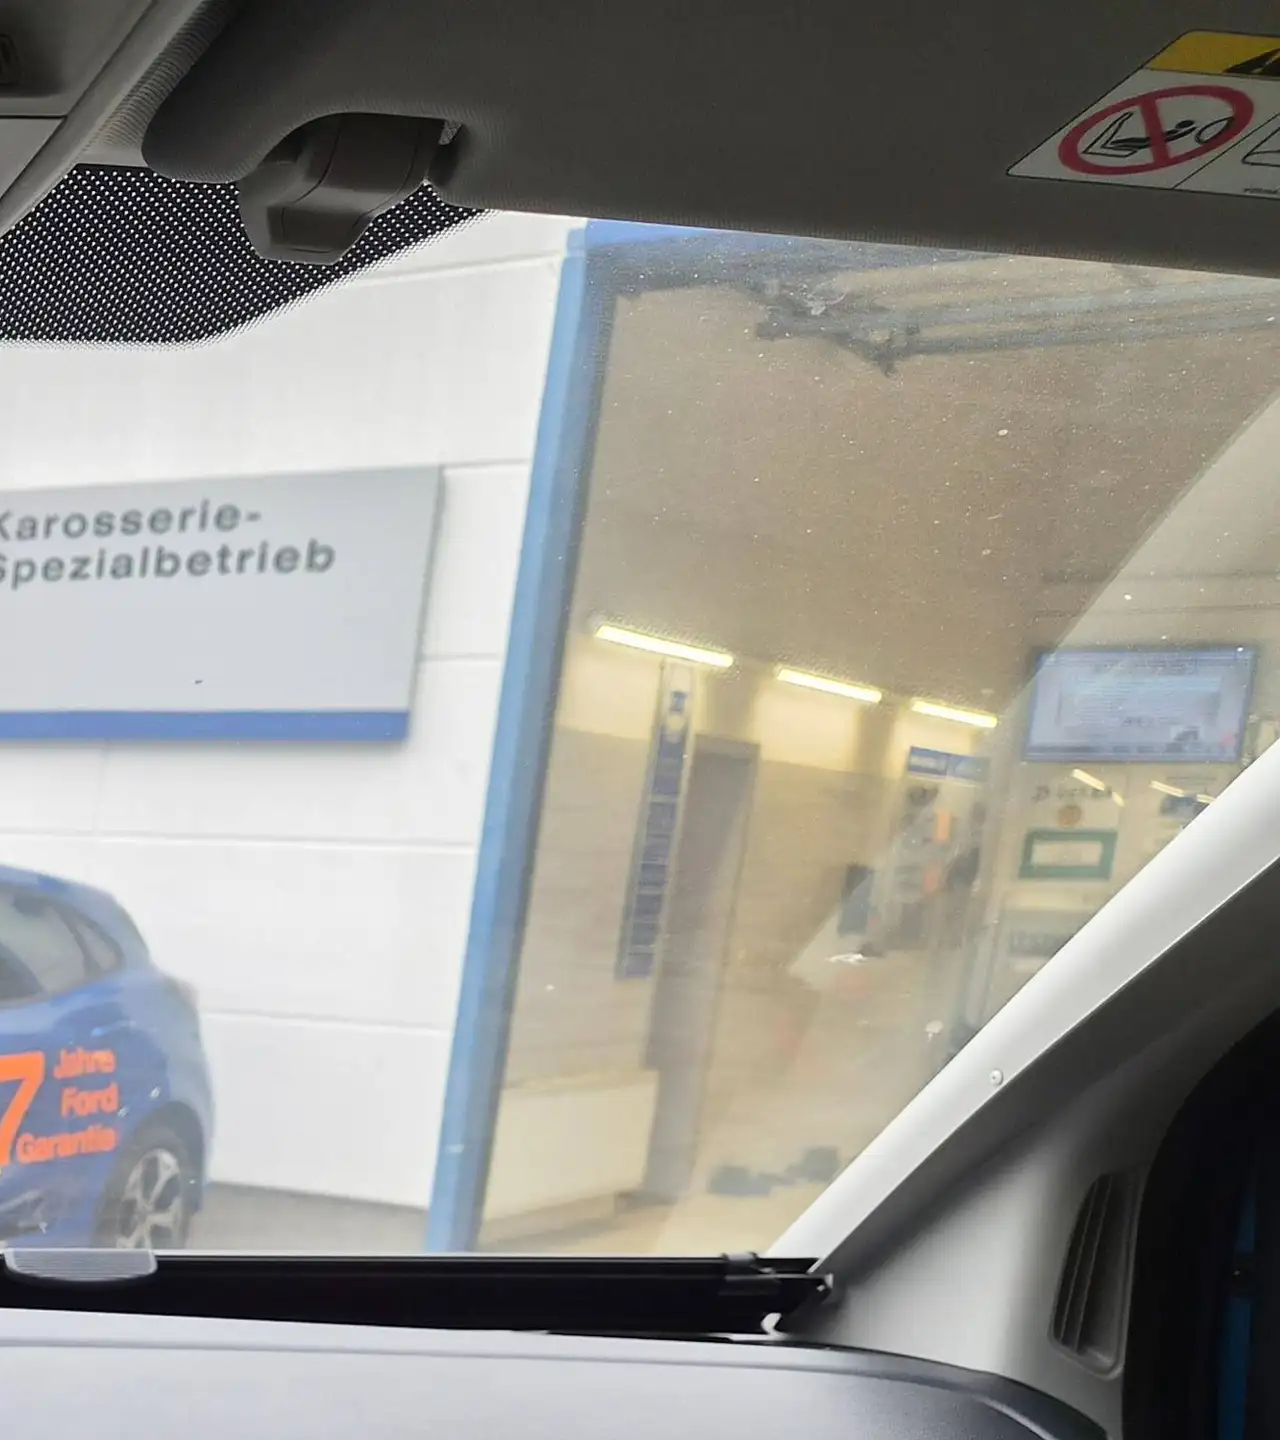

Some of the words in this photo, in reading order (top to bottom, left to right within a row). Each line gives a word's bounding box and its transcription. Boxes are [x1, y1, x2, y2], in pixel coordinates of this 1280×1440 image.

[53, 1046, 116, 1080] Jahre
[61, 1082, 119, 1118] Ford
[16, 1124, 118, 1165] Garantie
